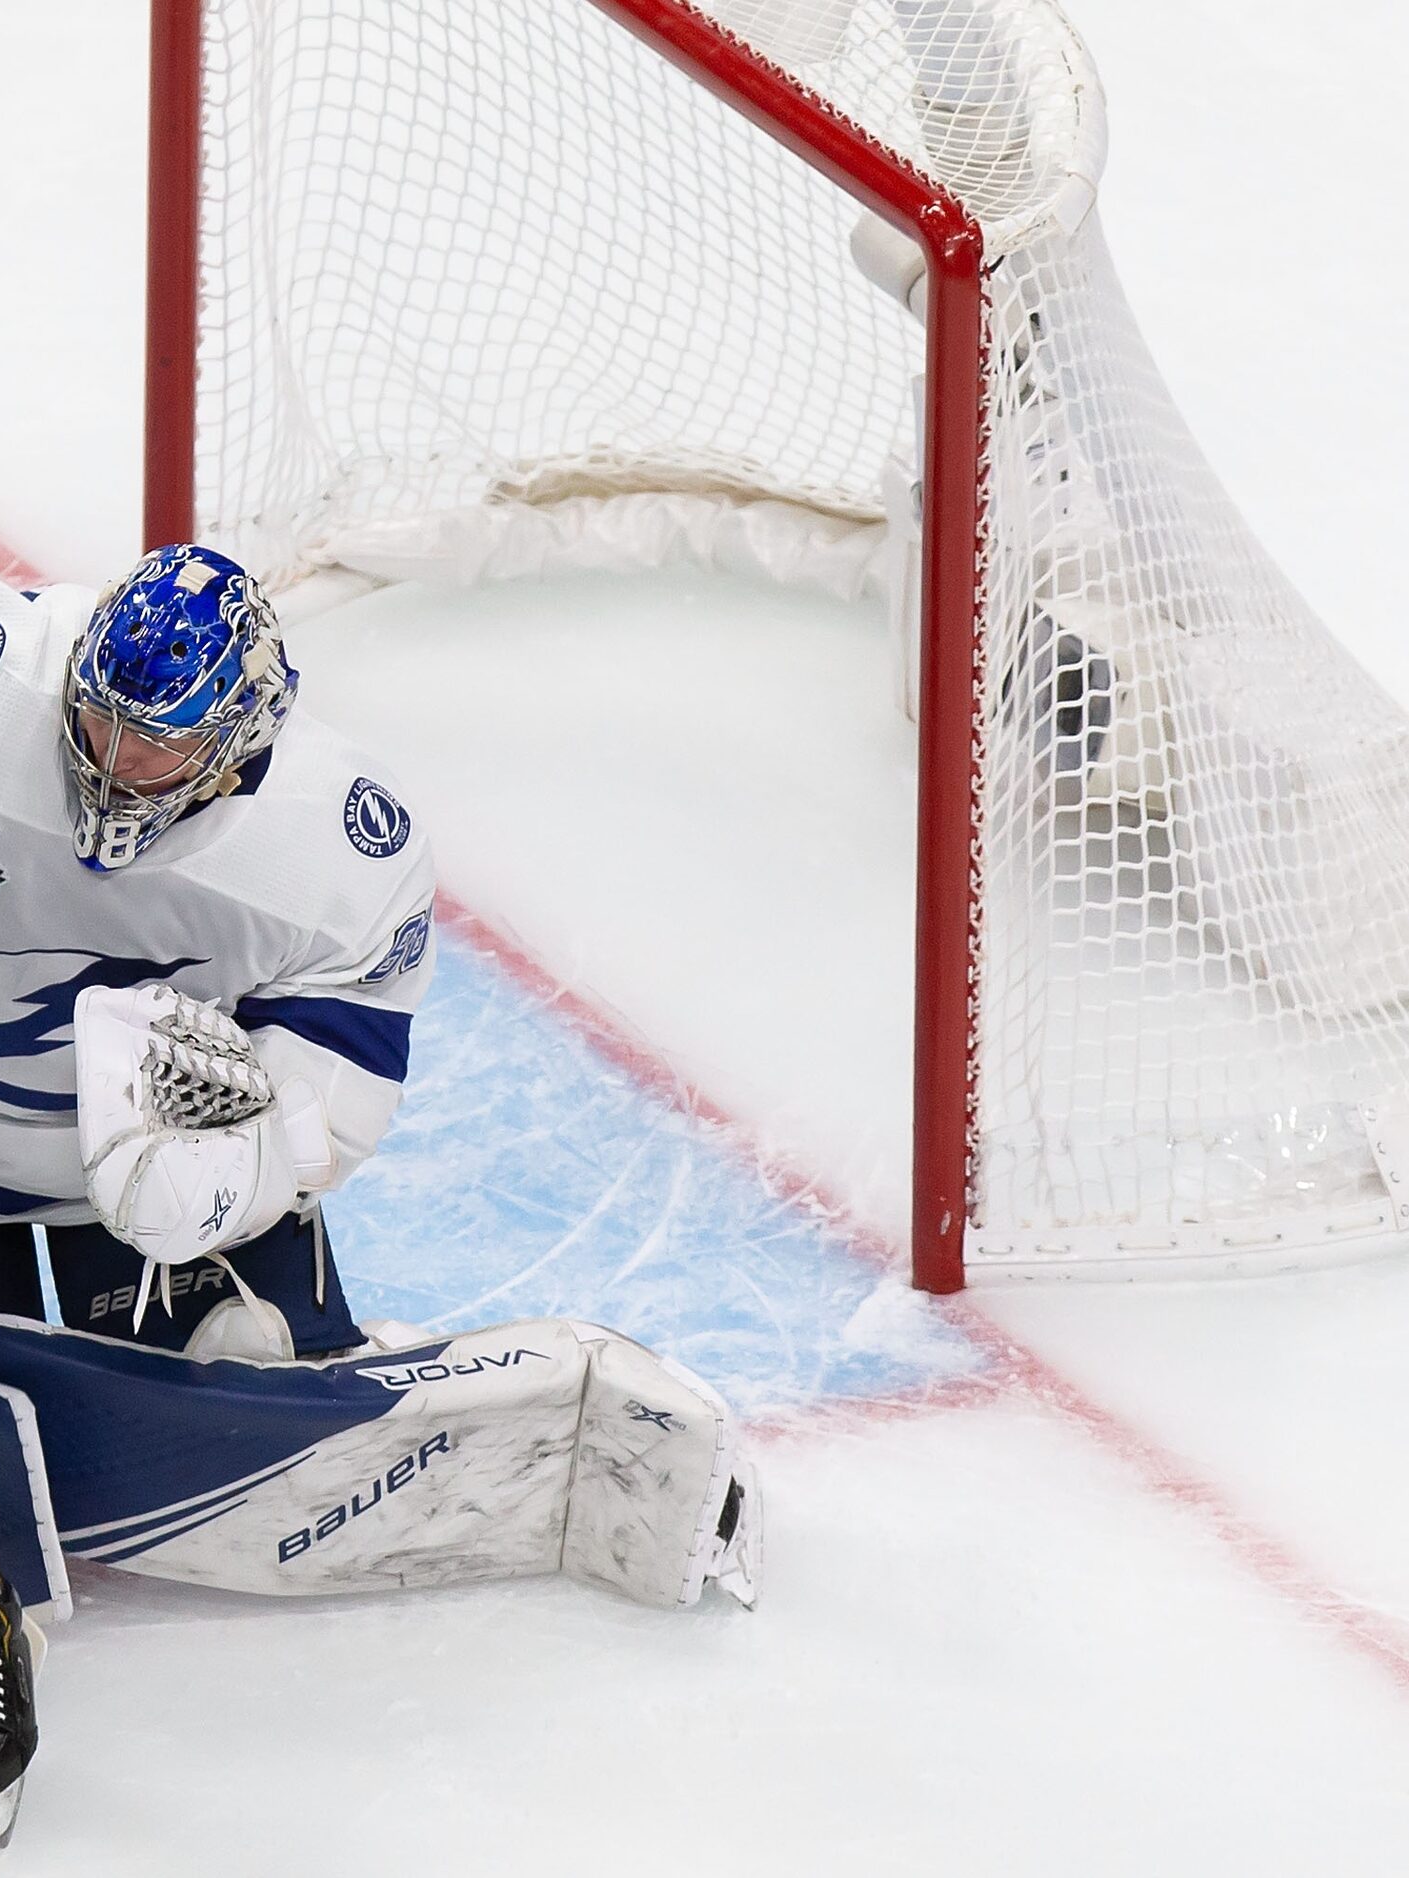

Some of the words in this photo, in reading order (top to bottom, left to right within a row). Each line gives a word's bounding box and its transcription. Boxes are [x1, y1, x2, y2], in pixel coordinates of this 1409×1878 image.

[346, 795, 359, 823] BAY
[73, 796, 141, 869] 88
[349, 825, 383, 855] TAMPA
[364, 1348, 552, 1386] VAPOR
[278, 1431, 450, 1564] BAUER
